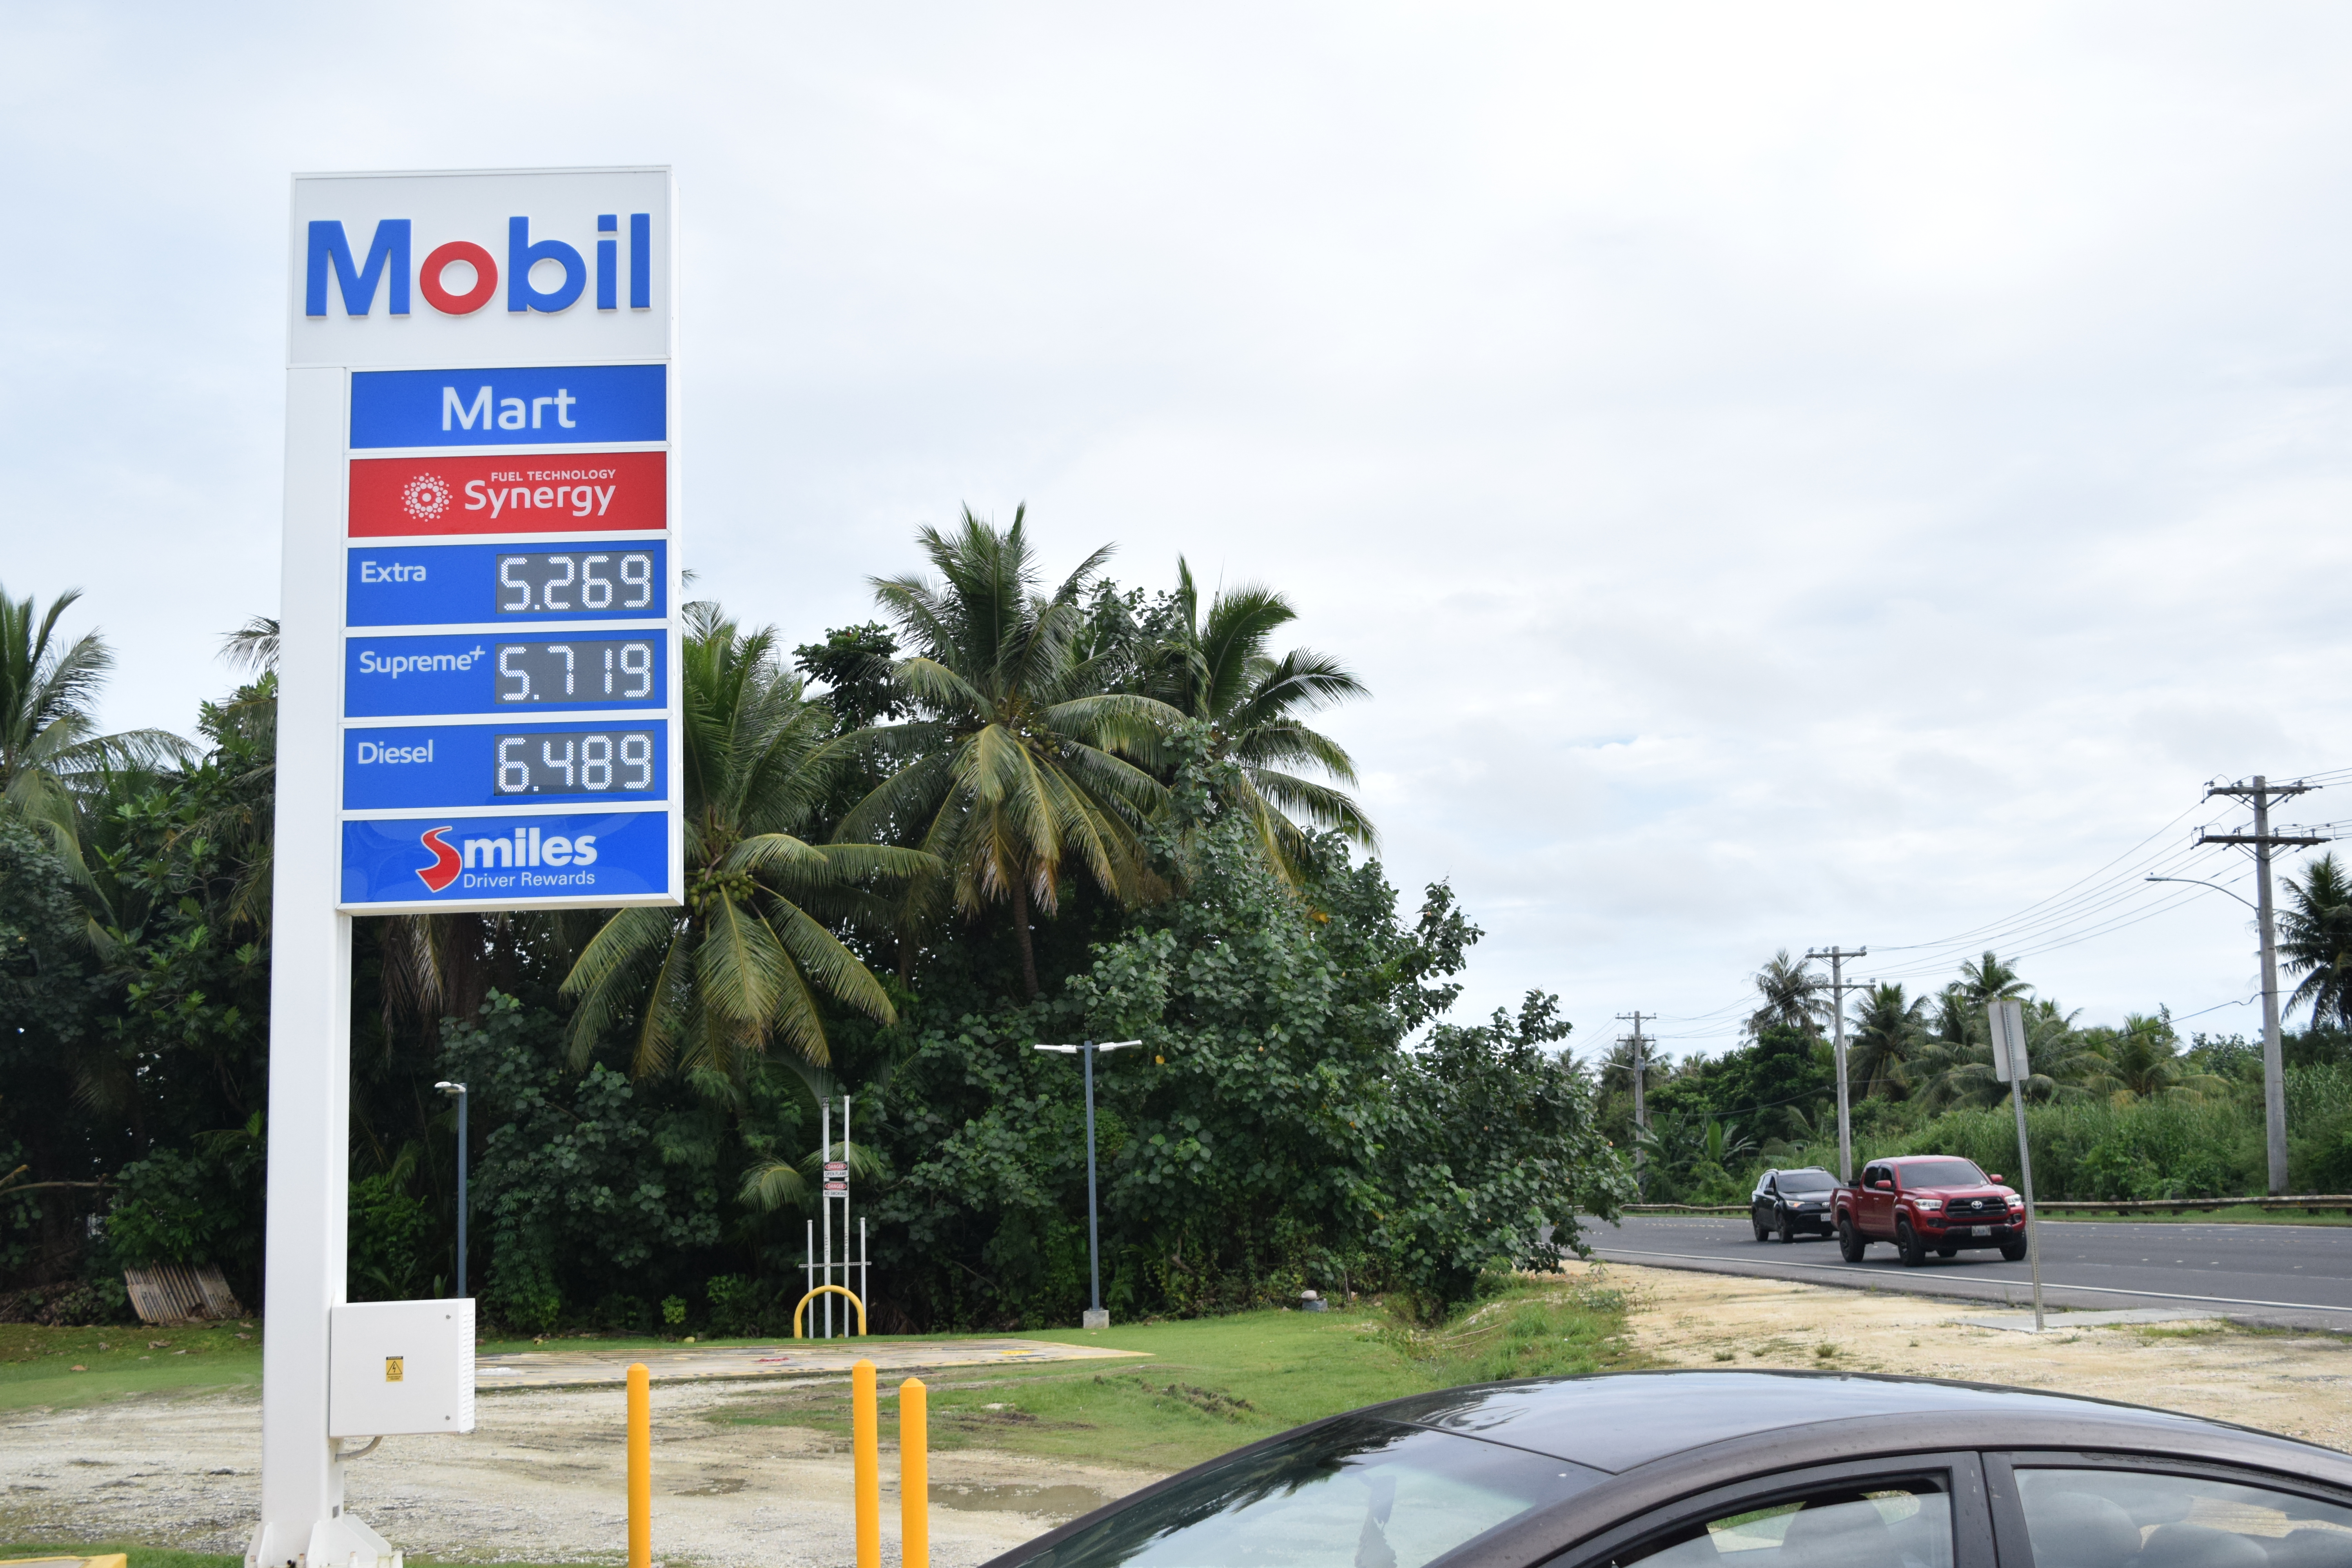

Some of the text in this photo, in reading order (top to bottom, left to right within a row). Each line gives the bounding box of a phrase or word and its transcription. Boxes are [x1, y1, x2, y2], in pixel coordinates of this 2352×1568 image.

[306, 214, 650, 316] Mobil
[443, 386, 575, 431] Mart
[491, 469, 616, 482] FUEL TECHNOLOGY
[465, 480, 616, 519] Synergy
[361, 561, 426, 583] Extra
[500, 554, 651, 611] 5.269
[360, 645, 485, 679] Supreme+
[499, 643, 651, 701] 5.719
[358, 739, 433, 764] Diesel
[498, 734, 651, 792] 6.489
[416, 826, 597, 893] Smiles
[464, 871, 595, 889] Driver Rewards
